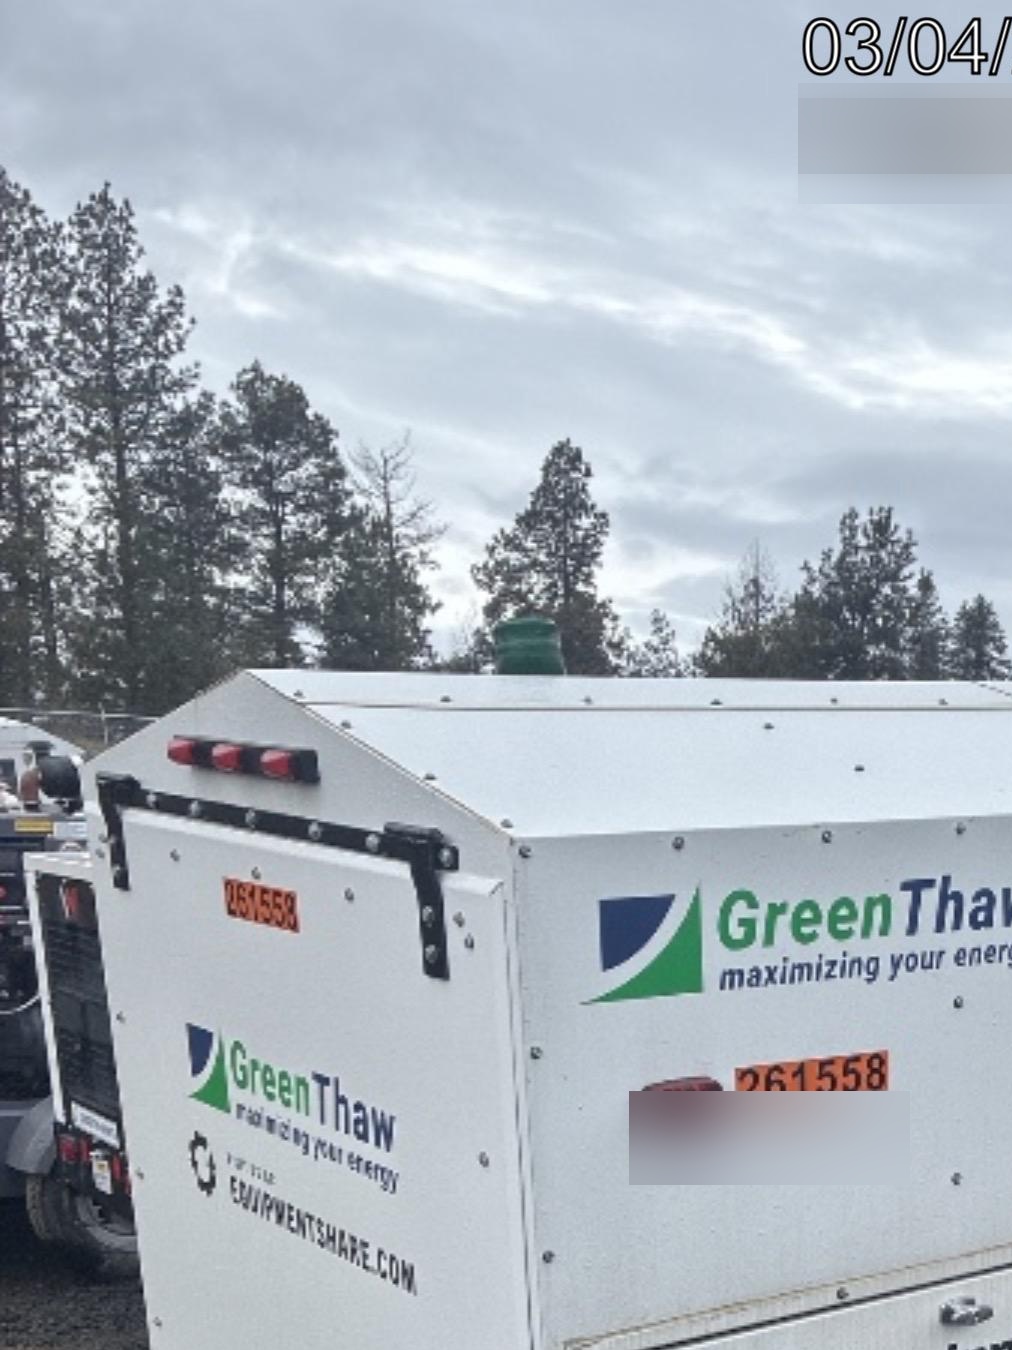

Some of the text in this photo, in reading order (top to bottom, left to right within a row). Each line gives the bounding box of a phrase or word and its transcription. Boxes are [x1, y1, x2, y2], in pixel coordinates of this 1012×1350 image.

[224, 878, 299, 933] 261558
[720, 951, 880, 990] maximizing
[888, 949, 945, 981] your
[230, 1040, 396, 1152] GreenThaw
[236, 1103, 399, 1194] maximizing your energy
[230, 1175, 417, 1295] EQUIPMENTSHARE.COM
